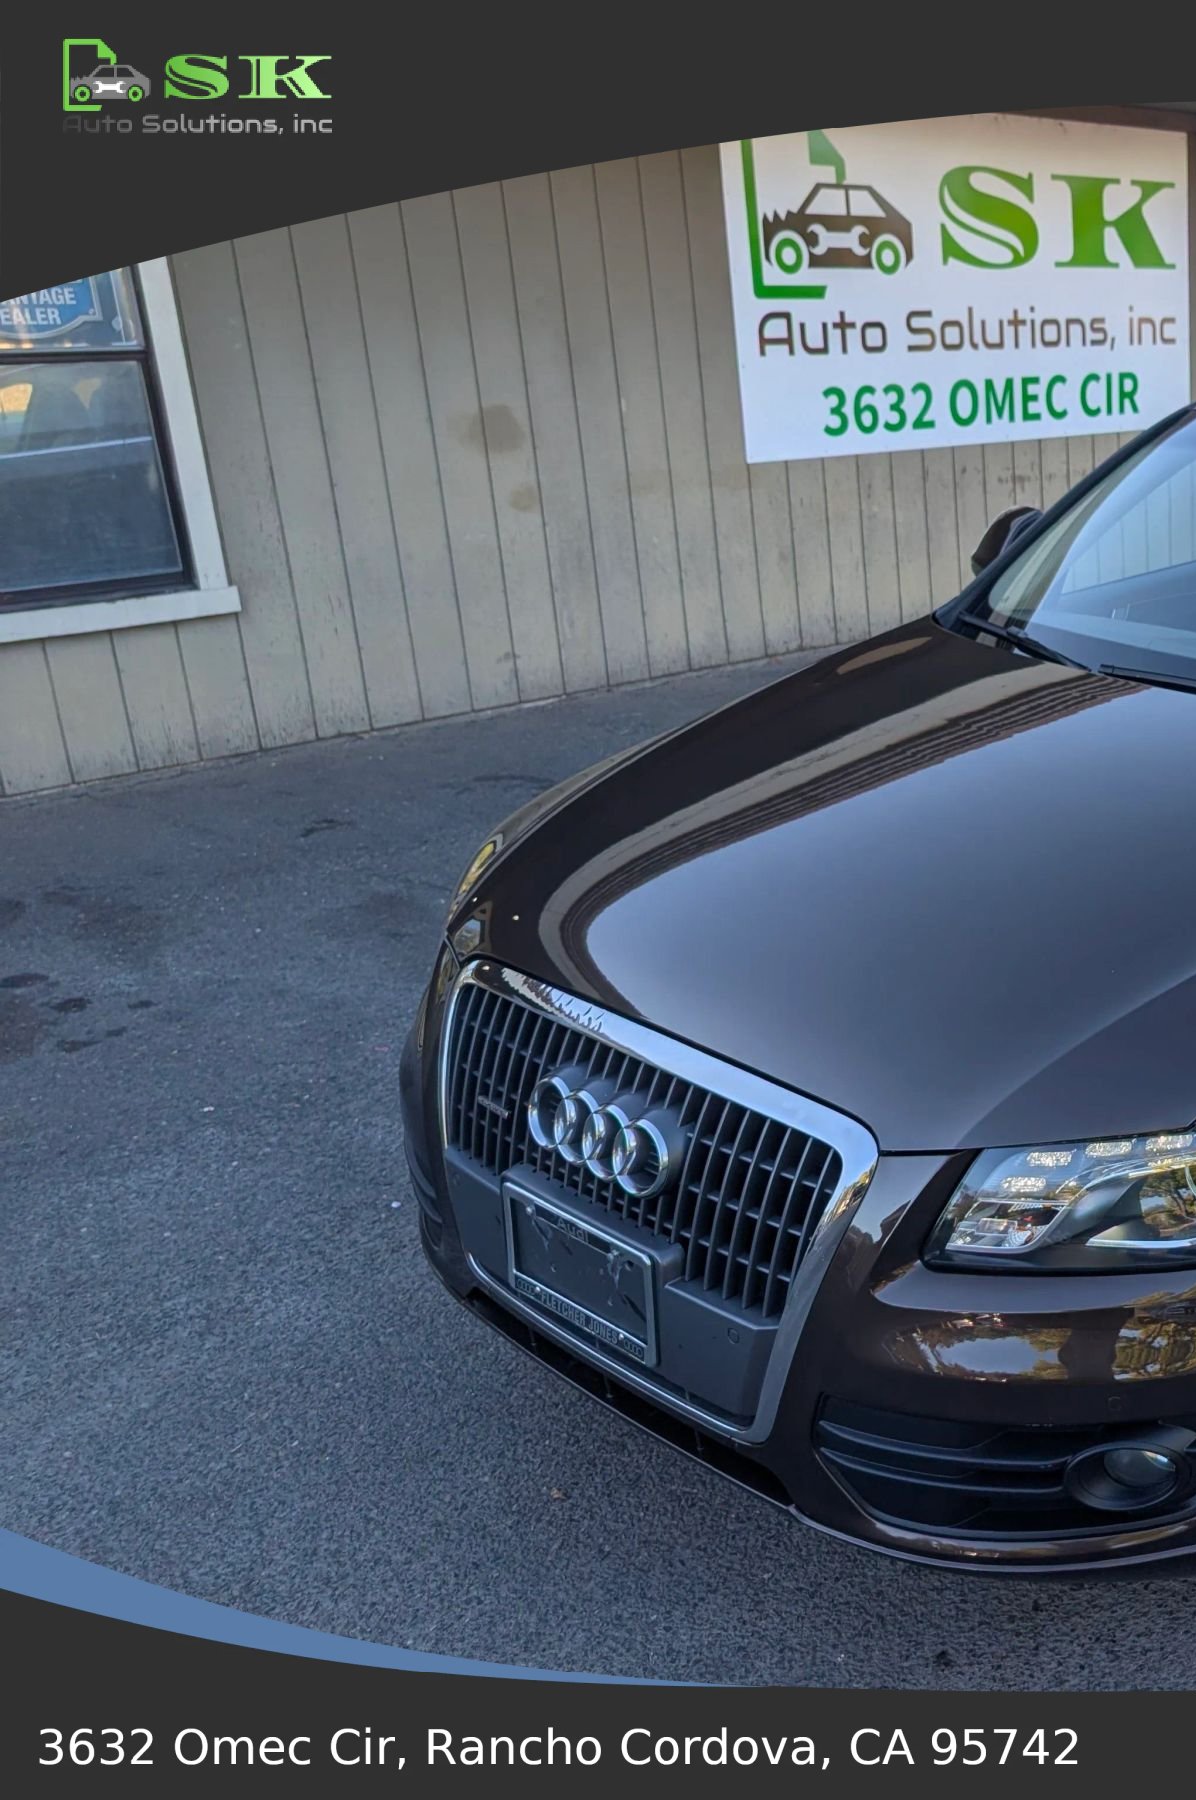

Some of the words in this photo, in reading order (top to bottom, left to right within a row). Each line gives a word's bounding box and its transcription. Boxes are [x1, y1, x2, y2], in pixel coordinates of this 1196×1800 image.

[938, 164, 1177, 270] SK
[758, 310, 888, 357] Auto
[905, 306, 1117, 353] Solutions,
[1129, 306, 1176, 346] inc
[822, 381, 935, 438] 3632
[948, 373, 1067, 427] OMEC
[1079, 371, 1140, 417] CIR
[556, 1217, 590, 1243] Audi
[540, 1292, 587, 1331] FLETCHER
[588, 1316, 619, 1346] JONES
